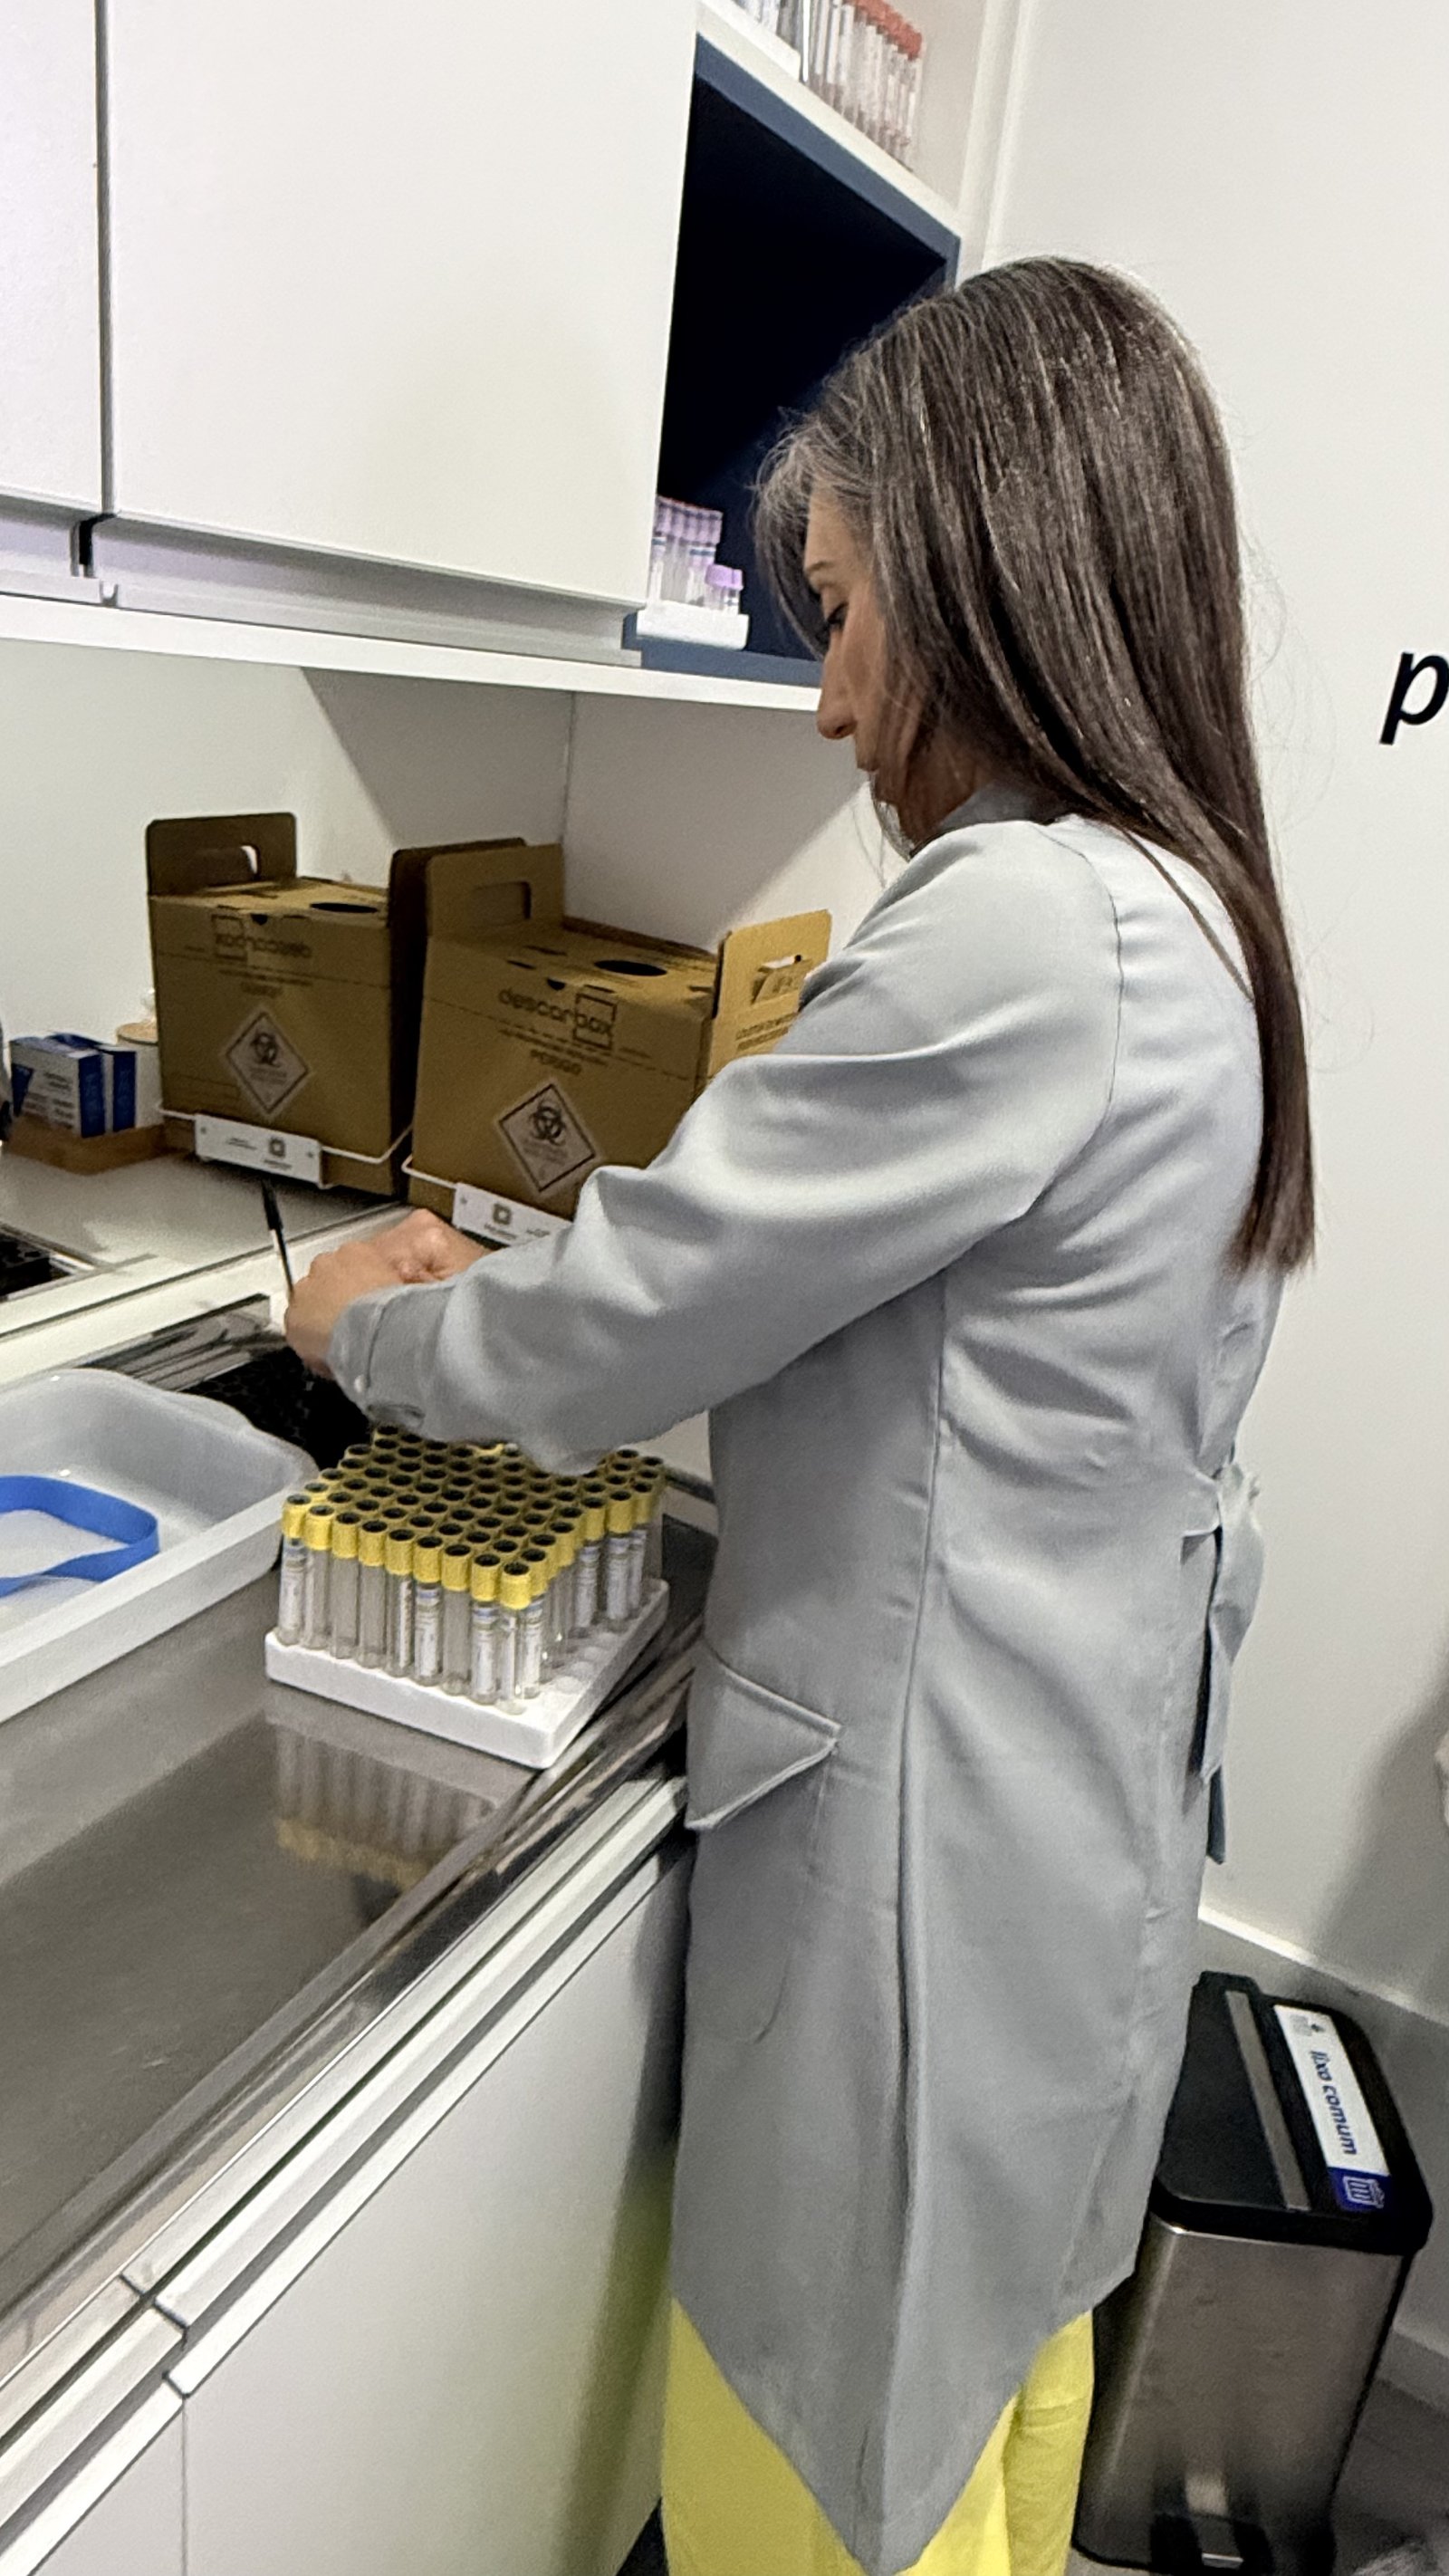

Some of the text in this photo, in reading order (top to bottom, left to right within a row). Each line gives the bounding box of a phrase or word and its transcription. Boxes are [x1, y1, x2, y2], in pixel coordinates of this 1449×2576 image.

[1379, 651, 1449, 745] p
[1310, 2050, 1357, 2155] lixo comum
